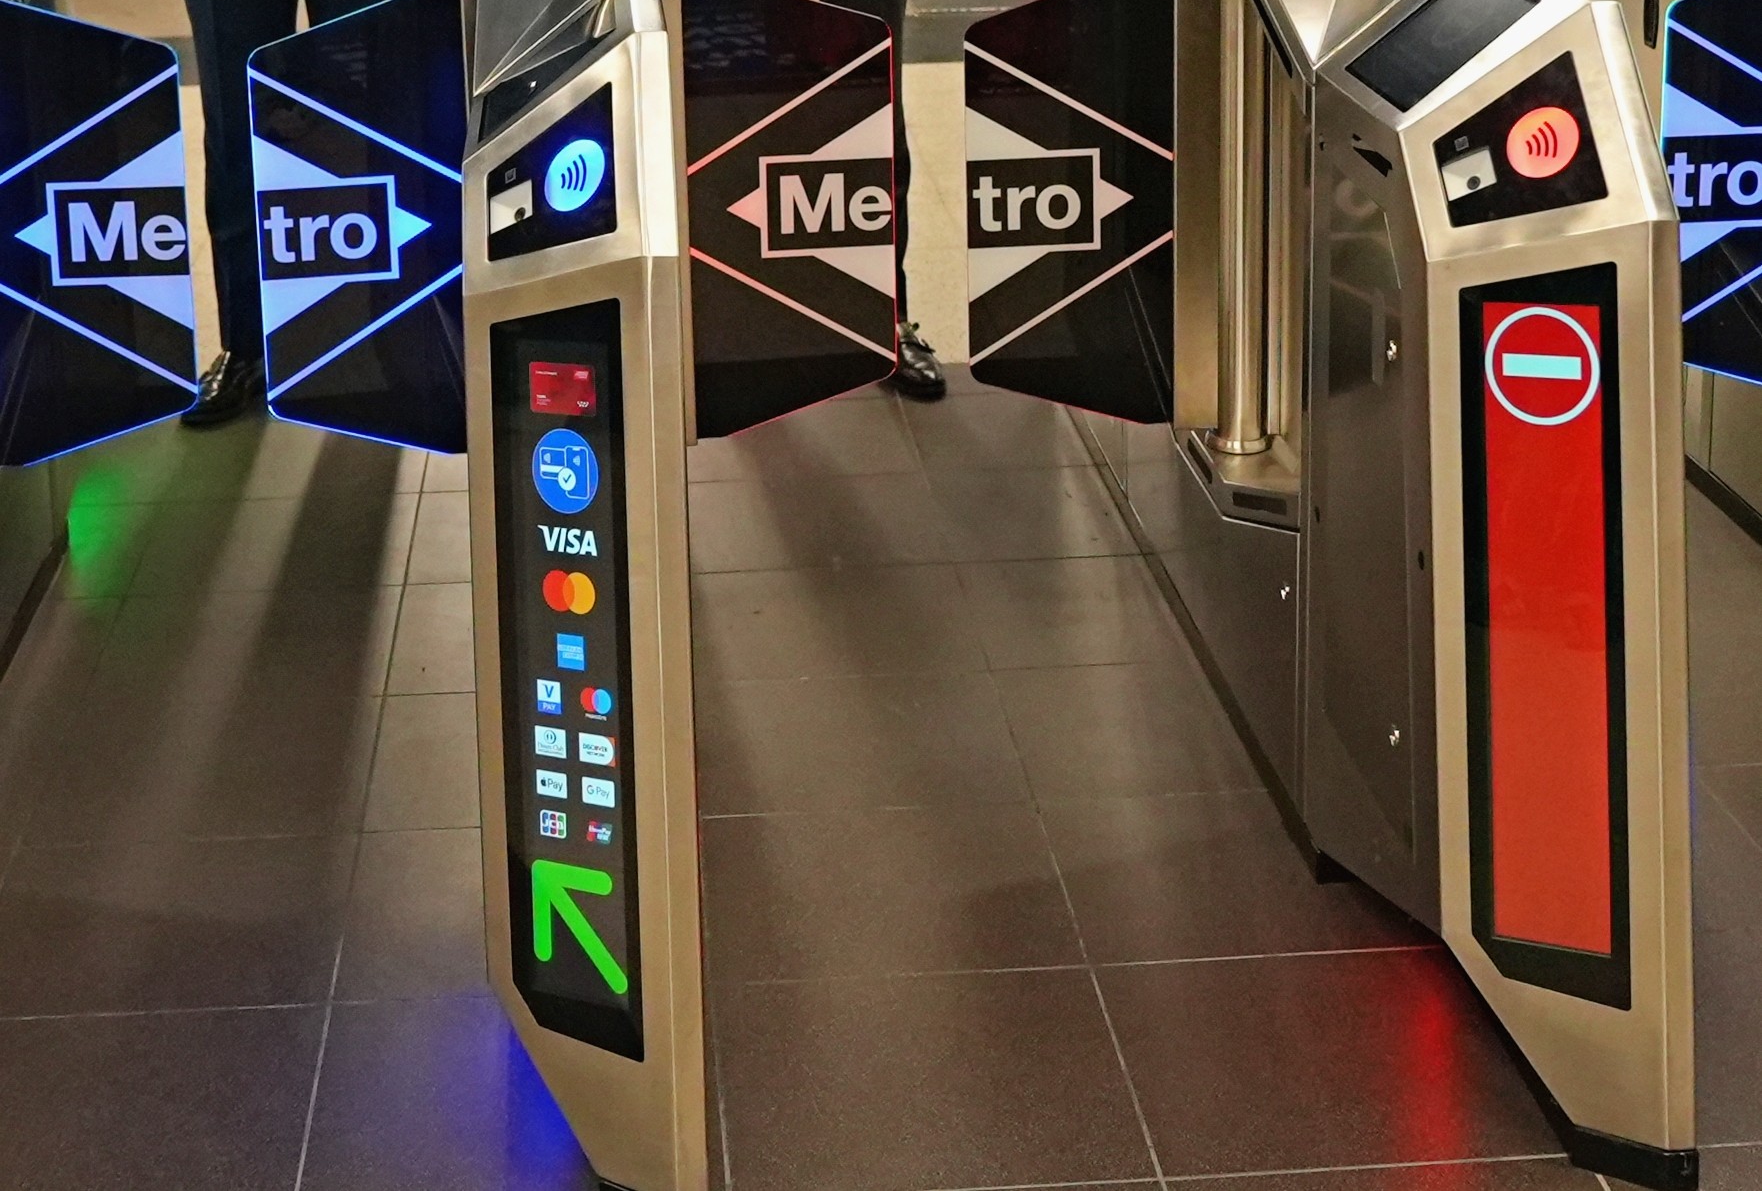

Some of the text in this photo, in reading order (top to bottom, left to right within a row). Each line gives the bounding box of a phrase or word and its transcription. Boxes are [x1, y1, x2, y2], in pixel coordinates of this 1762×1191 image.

[1667, 152, 1762, 208] tro
[779, 172, 893, 235] Me
[972, 175, 1082, 233] tro
[67, 200, 187, 263] Me
[263, 205, 378, 264] tro
[537, 524, 598, 557] VISA
[542, 683, 554, 699] V
[542, 702, 557, 711] PAY
[547, 778, 563, 792] Pay
[596, 787, 610, 799] Pay
